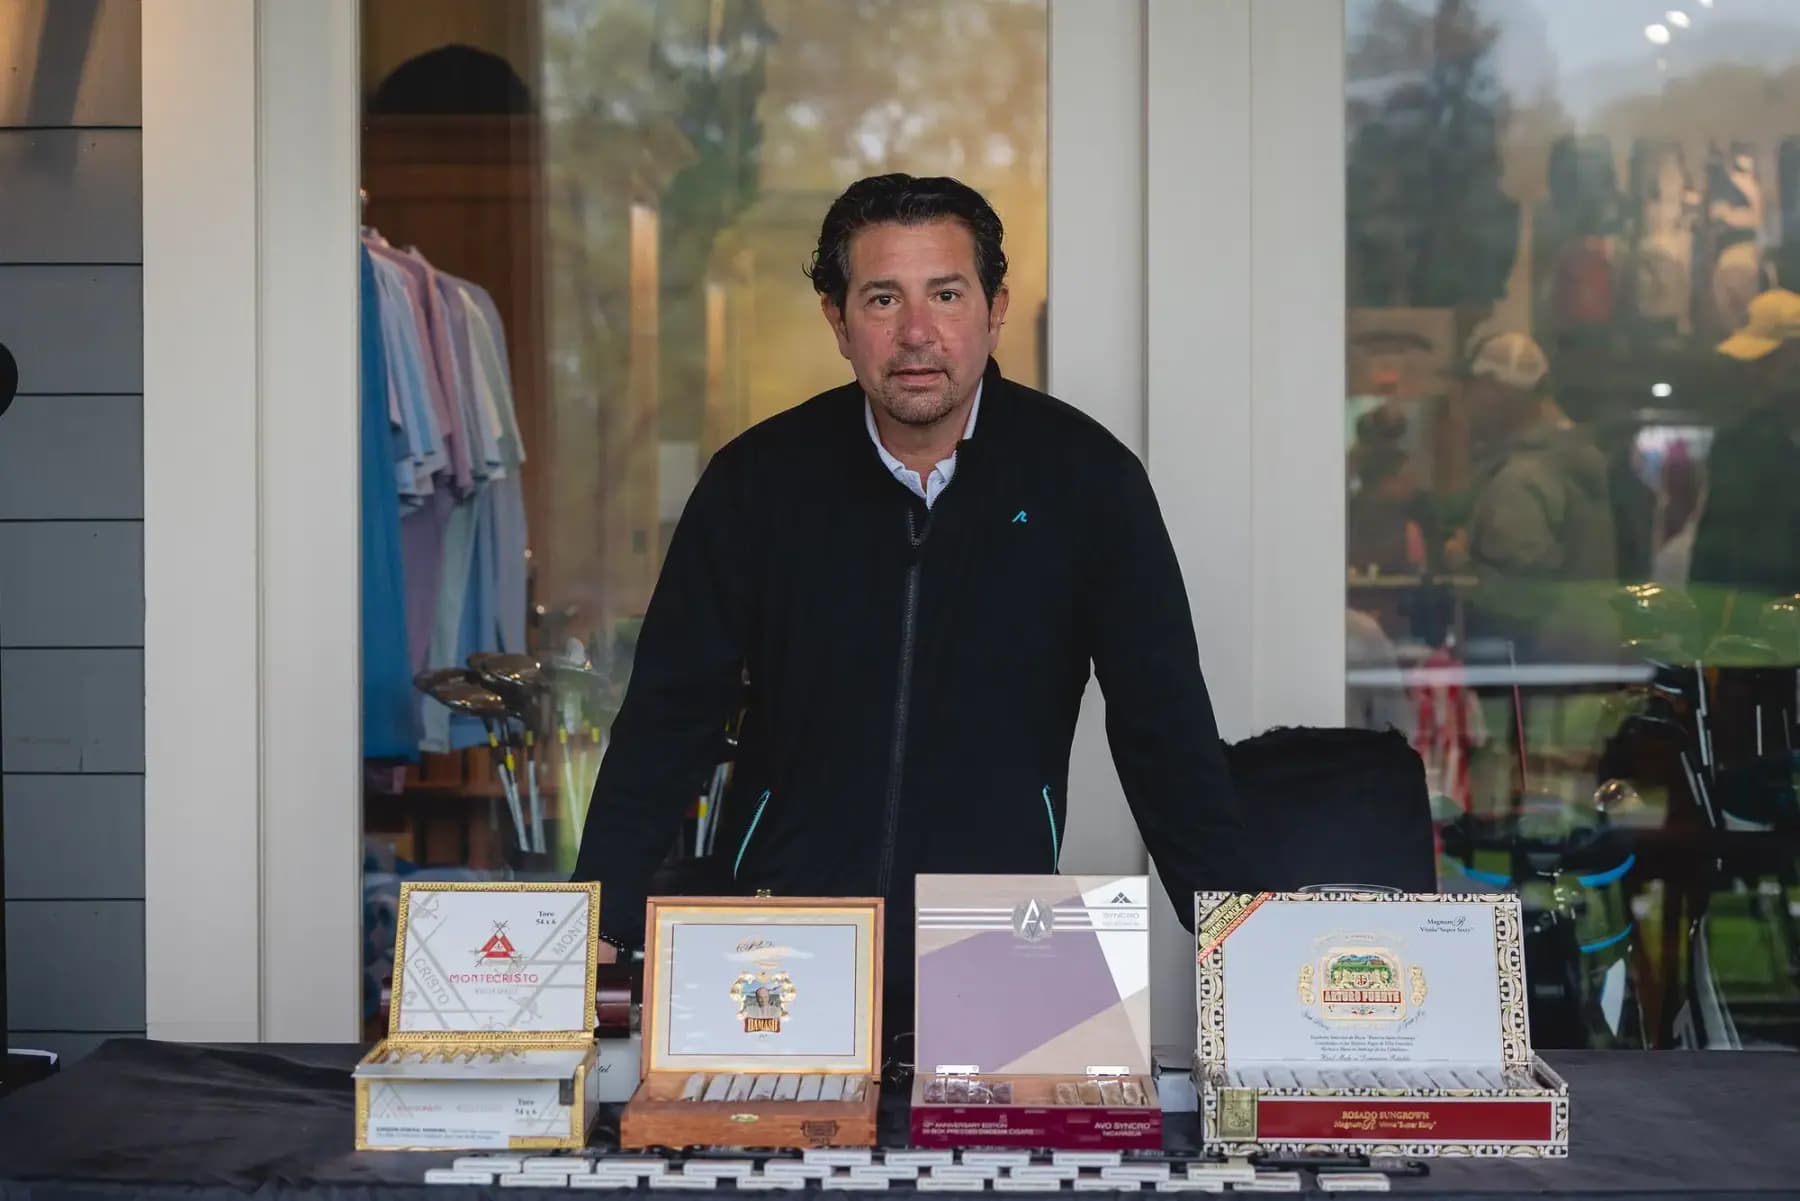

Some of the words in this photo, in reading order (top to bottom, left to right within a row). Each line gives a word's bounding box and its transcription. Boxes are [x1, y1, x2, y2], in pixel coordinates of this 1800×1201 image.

[538, 911, 555, 919] Toro
[413, 957, 450, 1005] CRISTO
[449, 973, 539, 984] MONTECRISTO
[1342, 1111, 1377, 1120] ROSADO
[1379, 1111, 1430, 1120] SUNGROWN
